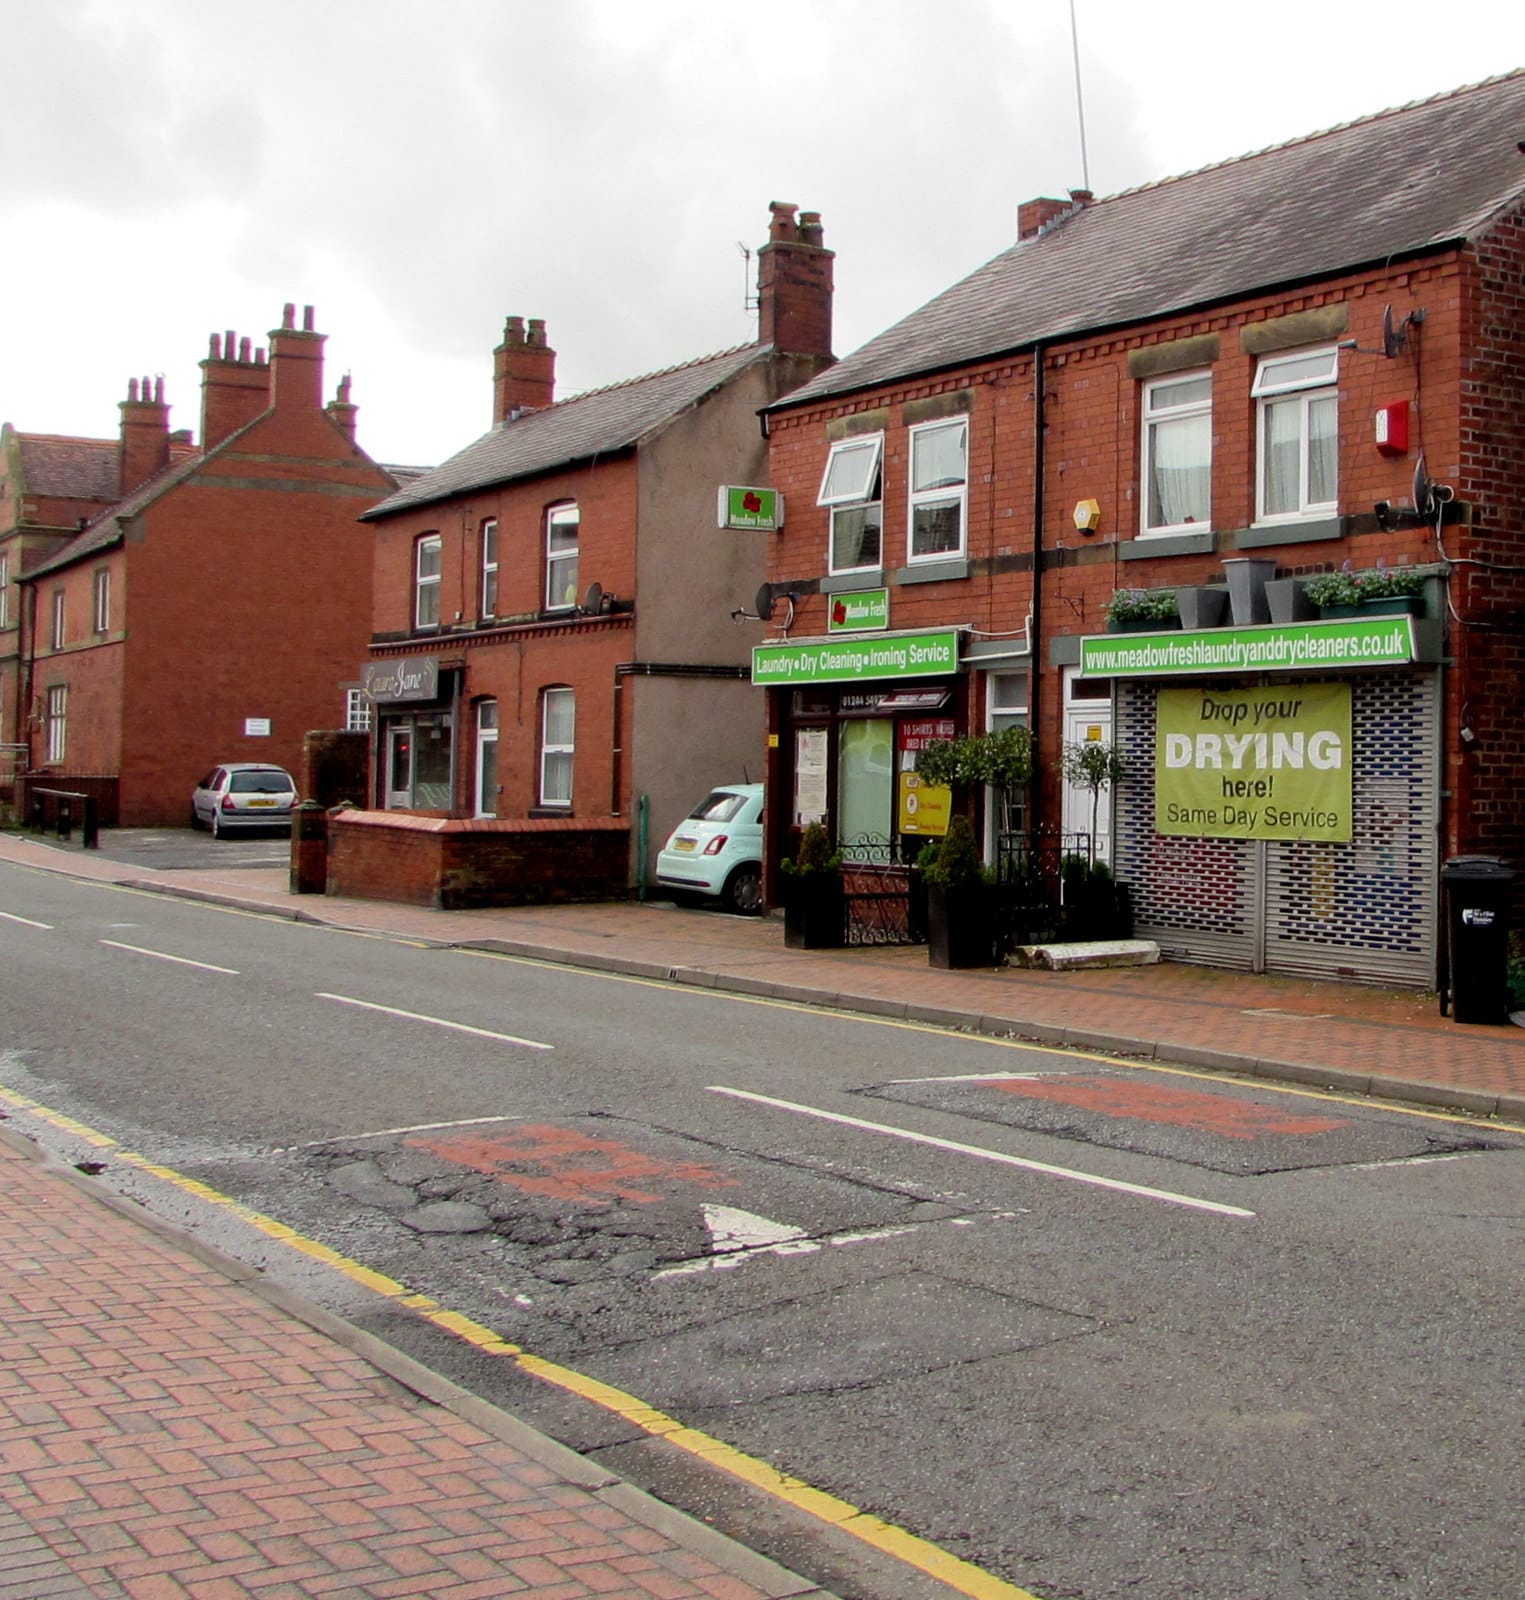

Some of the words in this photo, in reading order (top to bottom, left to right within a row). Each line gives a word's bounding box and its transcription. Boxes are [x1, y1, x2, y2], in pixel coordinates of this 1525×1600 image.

[757, 515, 774, 527] Fresh
[846, 600, 869, 618] Meadow
[870, 598, 887, 616] Fresh
[756, 655, 794, 676] Laundry
[800, 653, 817, 676] Dry
[820, 650, 863, 672] Cleaning
[870, 646, 906, 669] Ironing
[909, 642, 950, 664] Service
[1085, 628, 1404, 668] www.meadowfreshlaundryanddrycleaners.co.uk
[1200, 698, 1248, 726] Drop
[1254, 699, 1302, 726] your
[1165, 730, 1342, 770] DRYING
[1222, 775, 1274, 798] here!
[1167, 803, 1217, 825] Same
[1223, 805, 1258, 831] Day
[1264, 806, 1338, 828] Service
